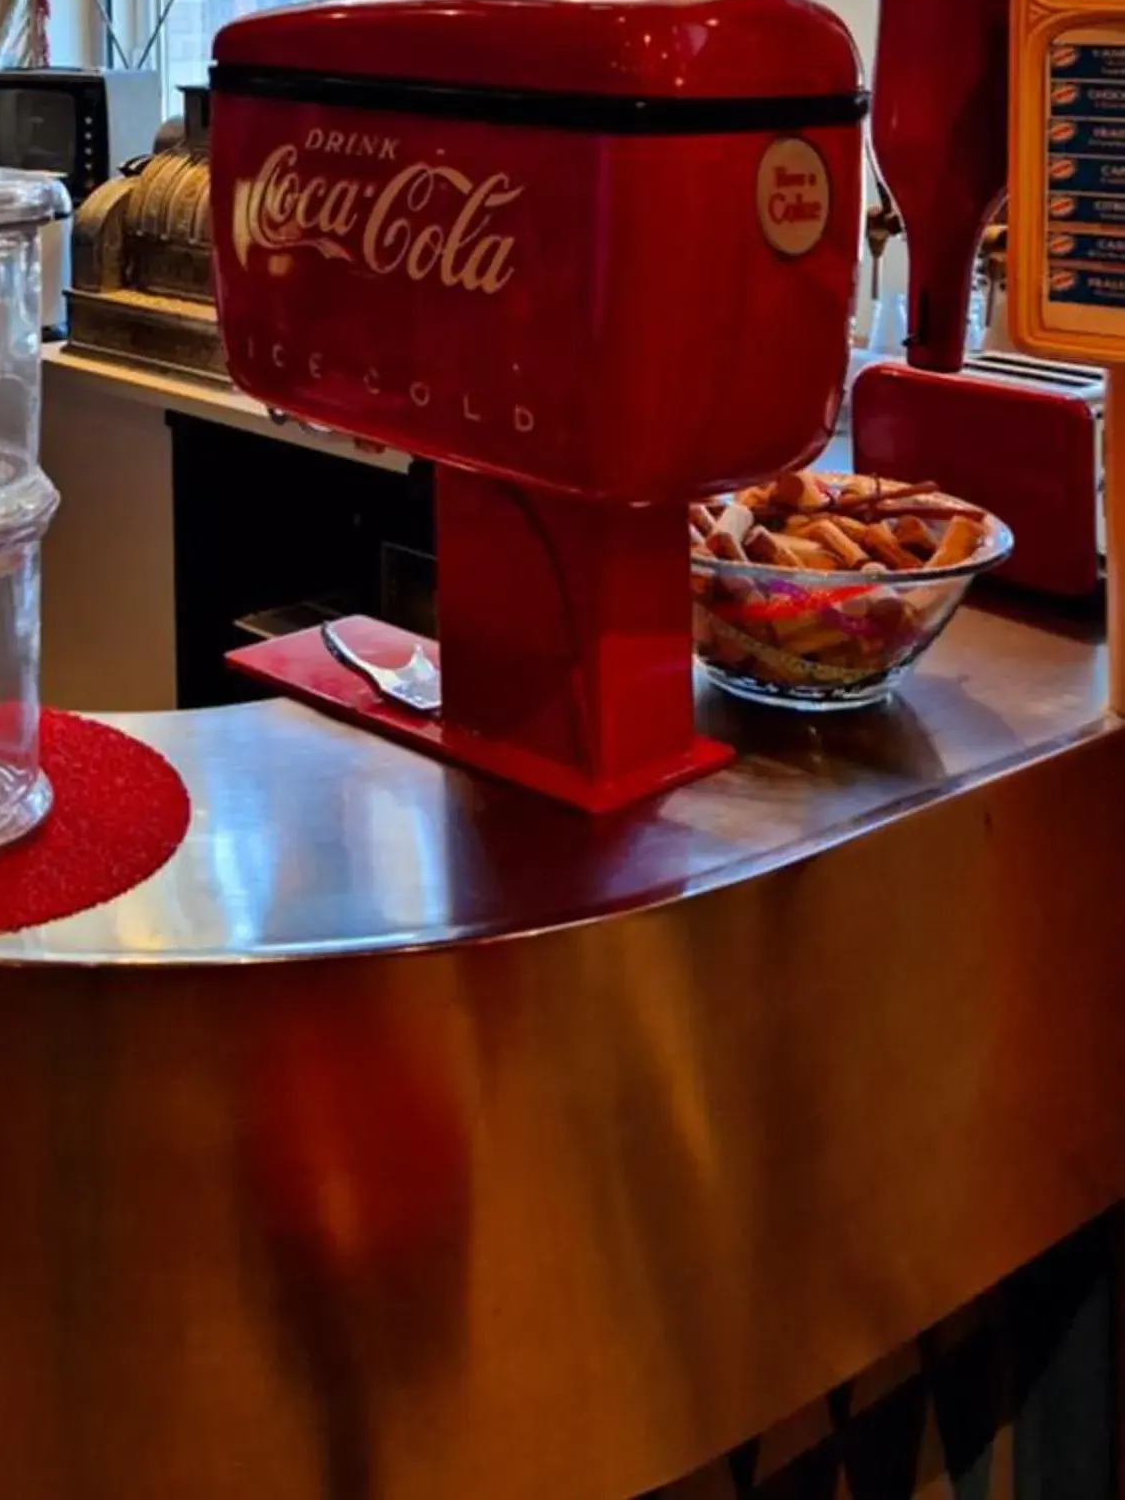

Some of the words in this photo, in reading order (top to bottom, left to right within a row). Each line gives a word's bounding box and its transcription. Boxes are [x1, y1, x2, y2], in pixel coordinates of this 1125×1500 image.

[305, 128, 401, 160] DRINK
[247, 143, 524, 295] Coca-Cola
[248, 336, 323, 379] ICE
[363, 366, 535, 432] COLD
